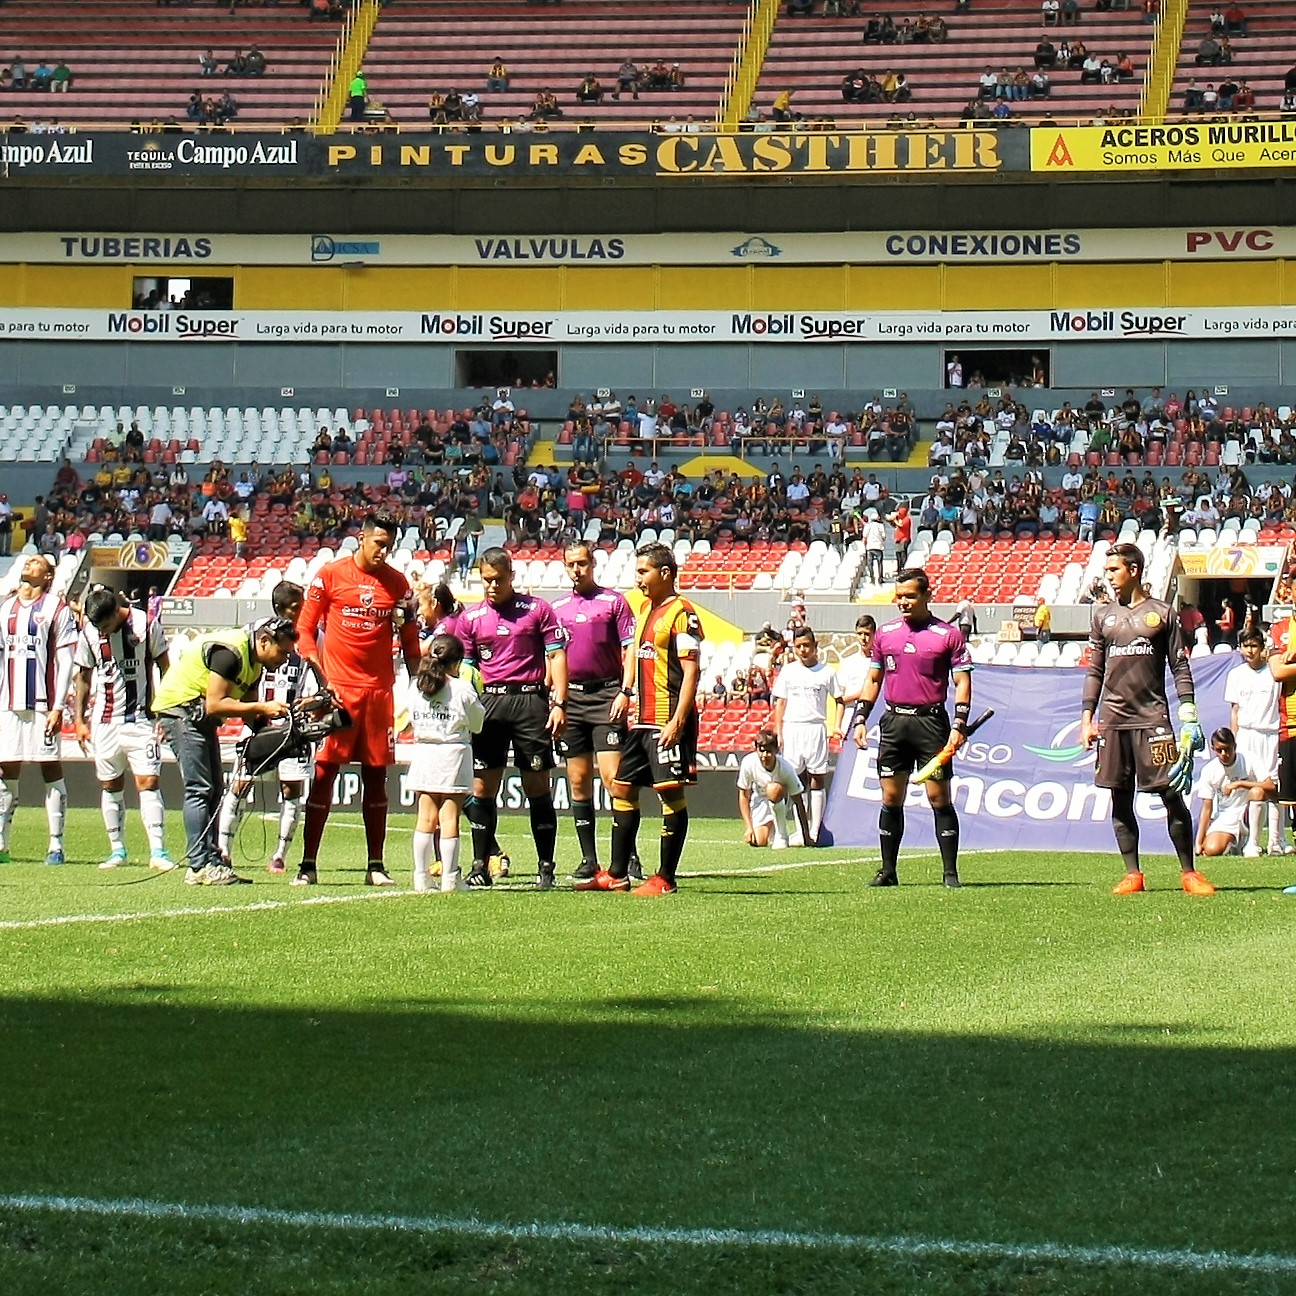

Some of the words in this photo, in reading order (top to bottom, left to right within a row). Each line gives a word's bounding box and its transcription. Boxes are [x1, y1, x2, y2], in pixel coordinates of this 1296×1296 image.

[1101, 127, 1200, 148] ACEROS
[46, 139, 93, 163] Azul
[127, 151, 176, 161] TEQUILA
[177, 139, 248, 167] Campo
[250, 140, 297, 164] Azul
[329, 144, 647, 166] PINTURAS
[656, 133, 1002, 172] CASTHER
[1103, 152, 1158, 165] Somos
[1168, 150, 1201, 163] Más
[1212, 150, 1245, 163] Que
[61, 237, 212, 258] TUBERIAS
[475, 239, 625, 260] VALVULAS
[885, 234, 1081, 255] CONEXIONES
[1187, 230, 1274, 253] PVC
[8, 321, 35, 334] para
[54, 322, 90, 333] motor
[108, 313, 169, 334] Mobil
[175, 315, 239, 336] Super
[256, 323, 290, 336] Larga
[293, 323, 318, 334] vida
[321, 323, 348, 336] para
[366, 324, 403, 334] motor
[421, 314, 482, 335] Mobil
[489, 317, 553, 337] Super
[567, 324, 601, 337] Larga
[604, 324, 629, 335] vida
[632, 325, 659, 337] para
[679, 324, 716, 334] motor
[731, 314, 794, 334] Mobil
[800, 316, 865, 337] Super
[878, 322, 914, 335] Larga
[916, 323, 942, 333] vida
[945, 323, 973, 335] para
[992, 323, 1030, 333] motor
[1050, 312, 1113, 332] Mobil
[1121, 313, 1186, 334] Super
[1204, 319, 1240, 332] Larga
[1242, 318, 1269, 329] vida
[136, 542, 149, 563] 6
[1228, 550, 1242, 571] 7
[1151, 741, 1177, 766] 30
